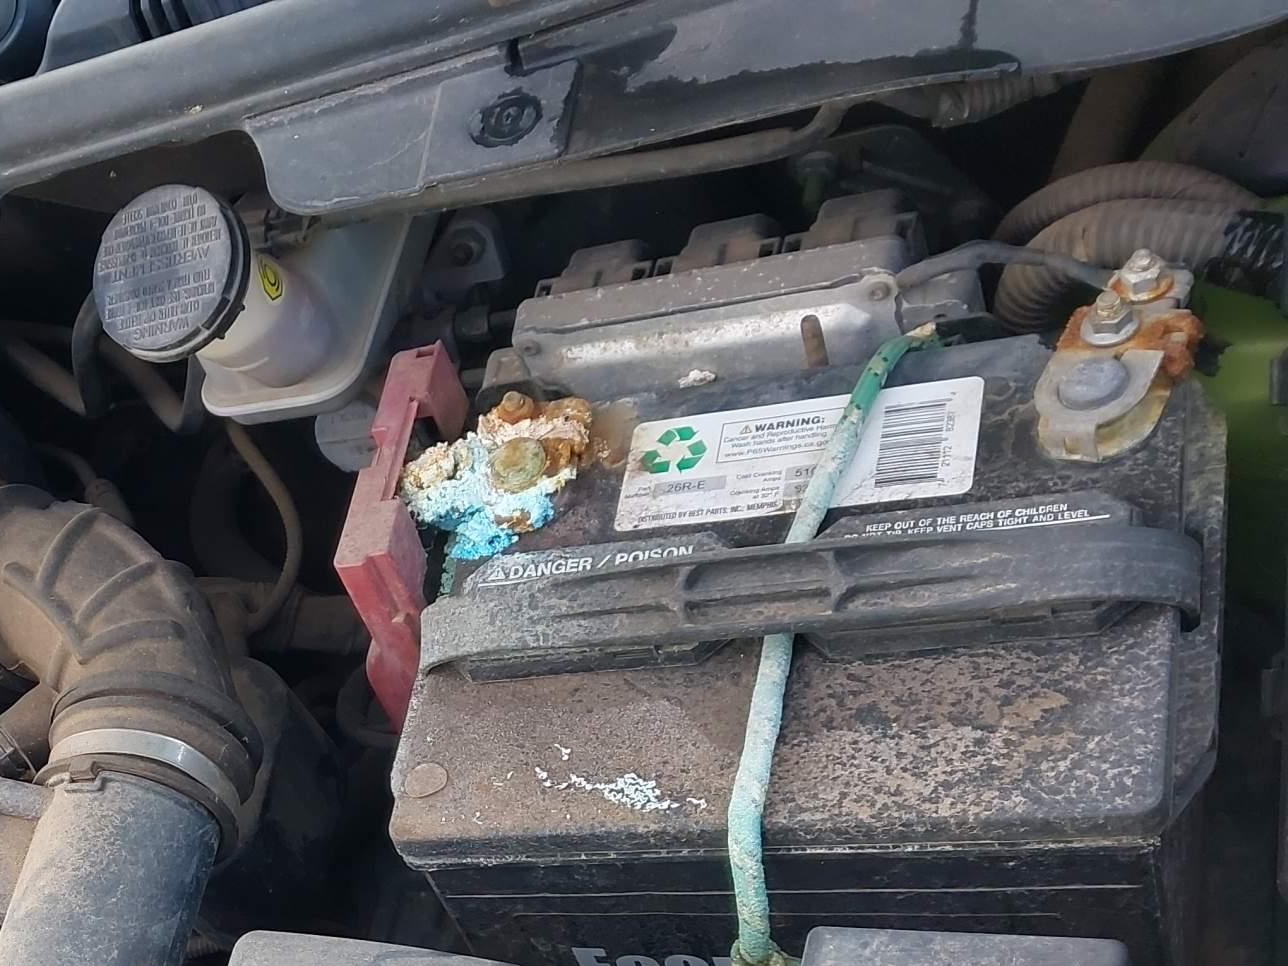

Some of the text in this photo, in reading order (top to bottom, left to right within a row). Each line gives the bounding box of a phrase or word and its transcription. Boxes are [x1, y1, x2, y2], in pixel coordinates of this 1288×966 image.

[754, 416, 825, 432] WARNING:
[723, 434, 750, 443] Cancer
[752, 432, 764, 440] and
[766, 426, 814, 438] Reproductive
[753, 438, 776, 446] hands
[666, 480, 705, 493] 26R-E
[866, 502, 1068, 532] KEEP OUT OF THE REACH OF CHILDREN
[936, 523, 964, 534] VENT
[966, 520, 994, 530] CAPS
[998, 516, 1030, 526] TIGHT
[1032, 512, 1055, 522] AND
[1058, 509, 1090, 520] LEVEL
[509, 556, 593, 580] DANGER
[614, 545, 694, 566] POISON
